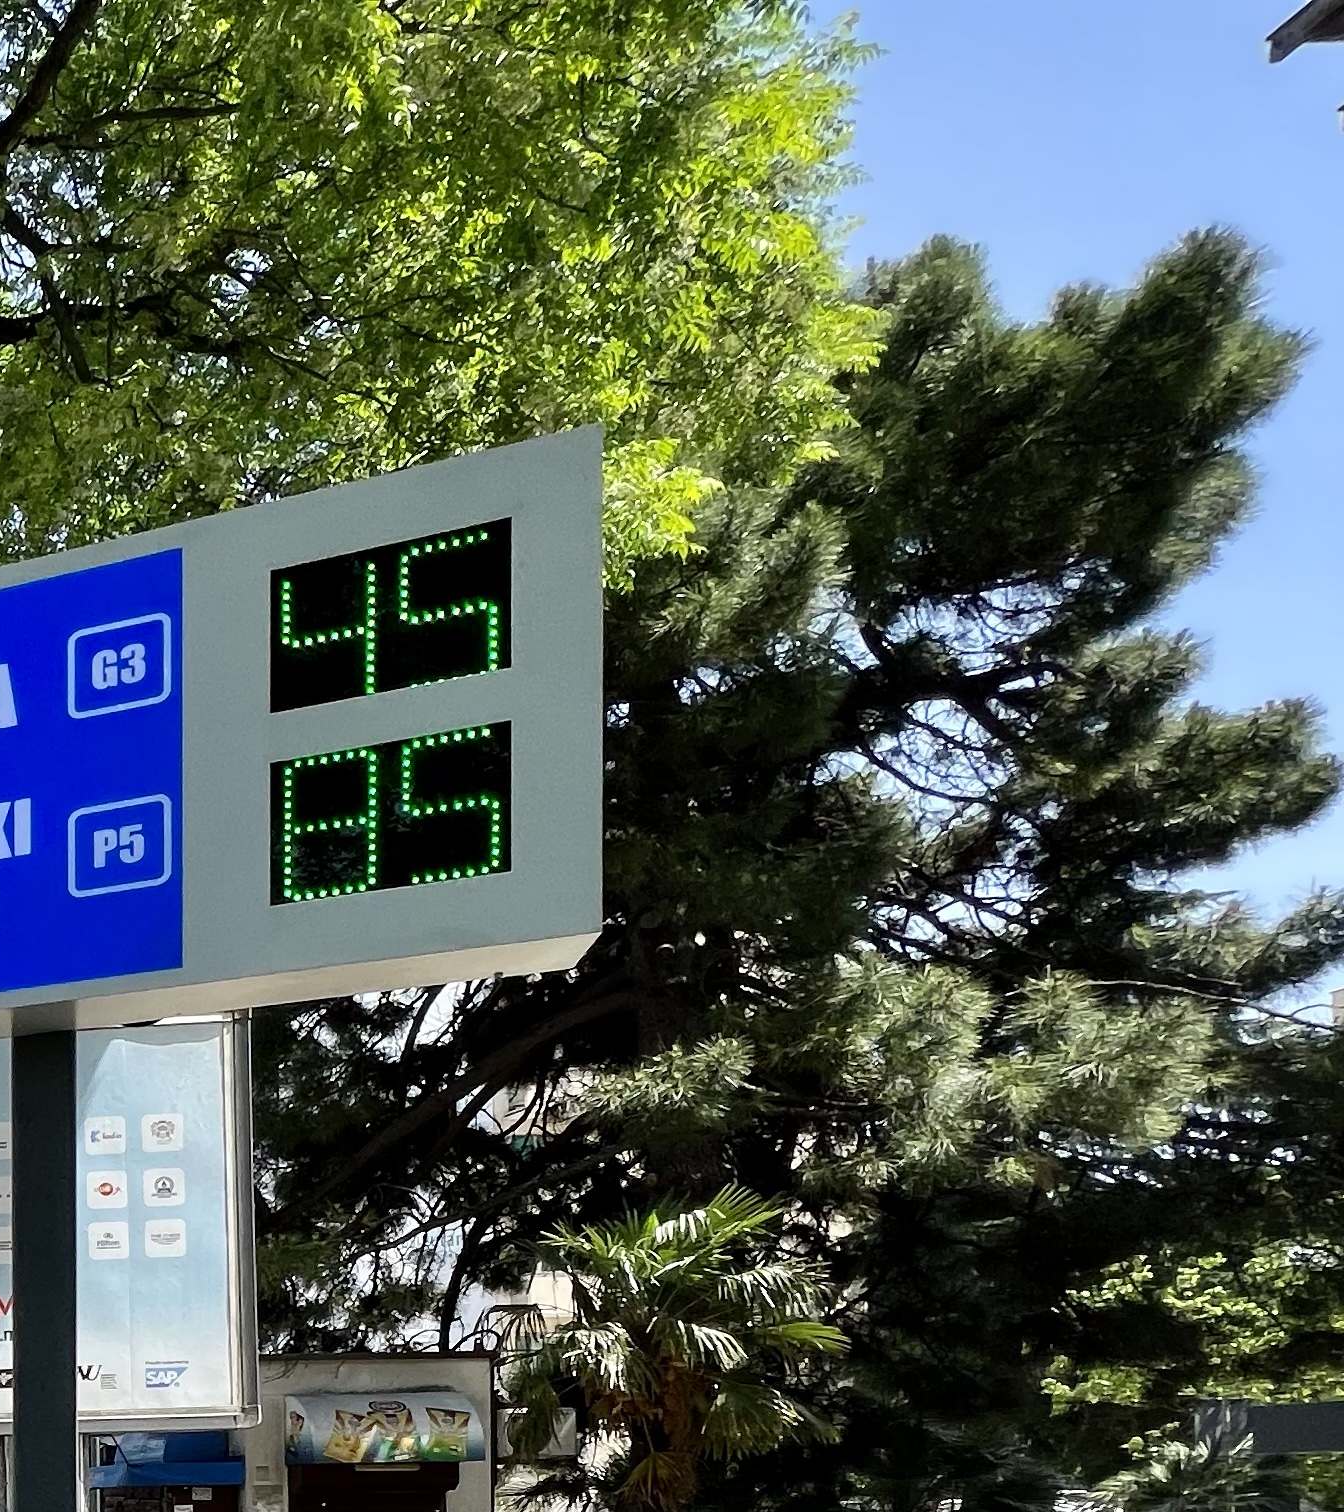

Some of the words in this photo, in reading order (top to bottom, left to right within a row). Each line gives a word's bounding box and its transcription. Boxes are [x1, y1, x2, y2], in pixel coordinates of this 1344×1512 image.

[281, 530, 499, 695] 45
[92, 643, 146, 690] G3
[284, 727, 500, 901] 85
[94, 824, 145, 868] P5
[146, 1370, 178, 1385] SAP
